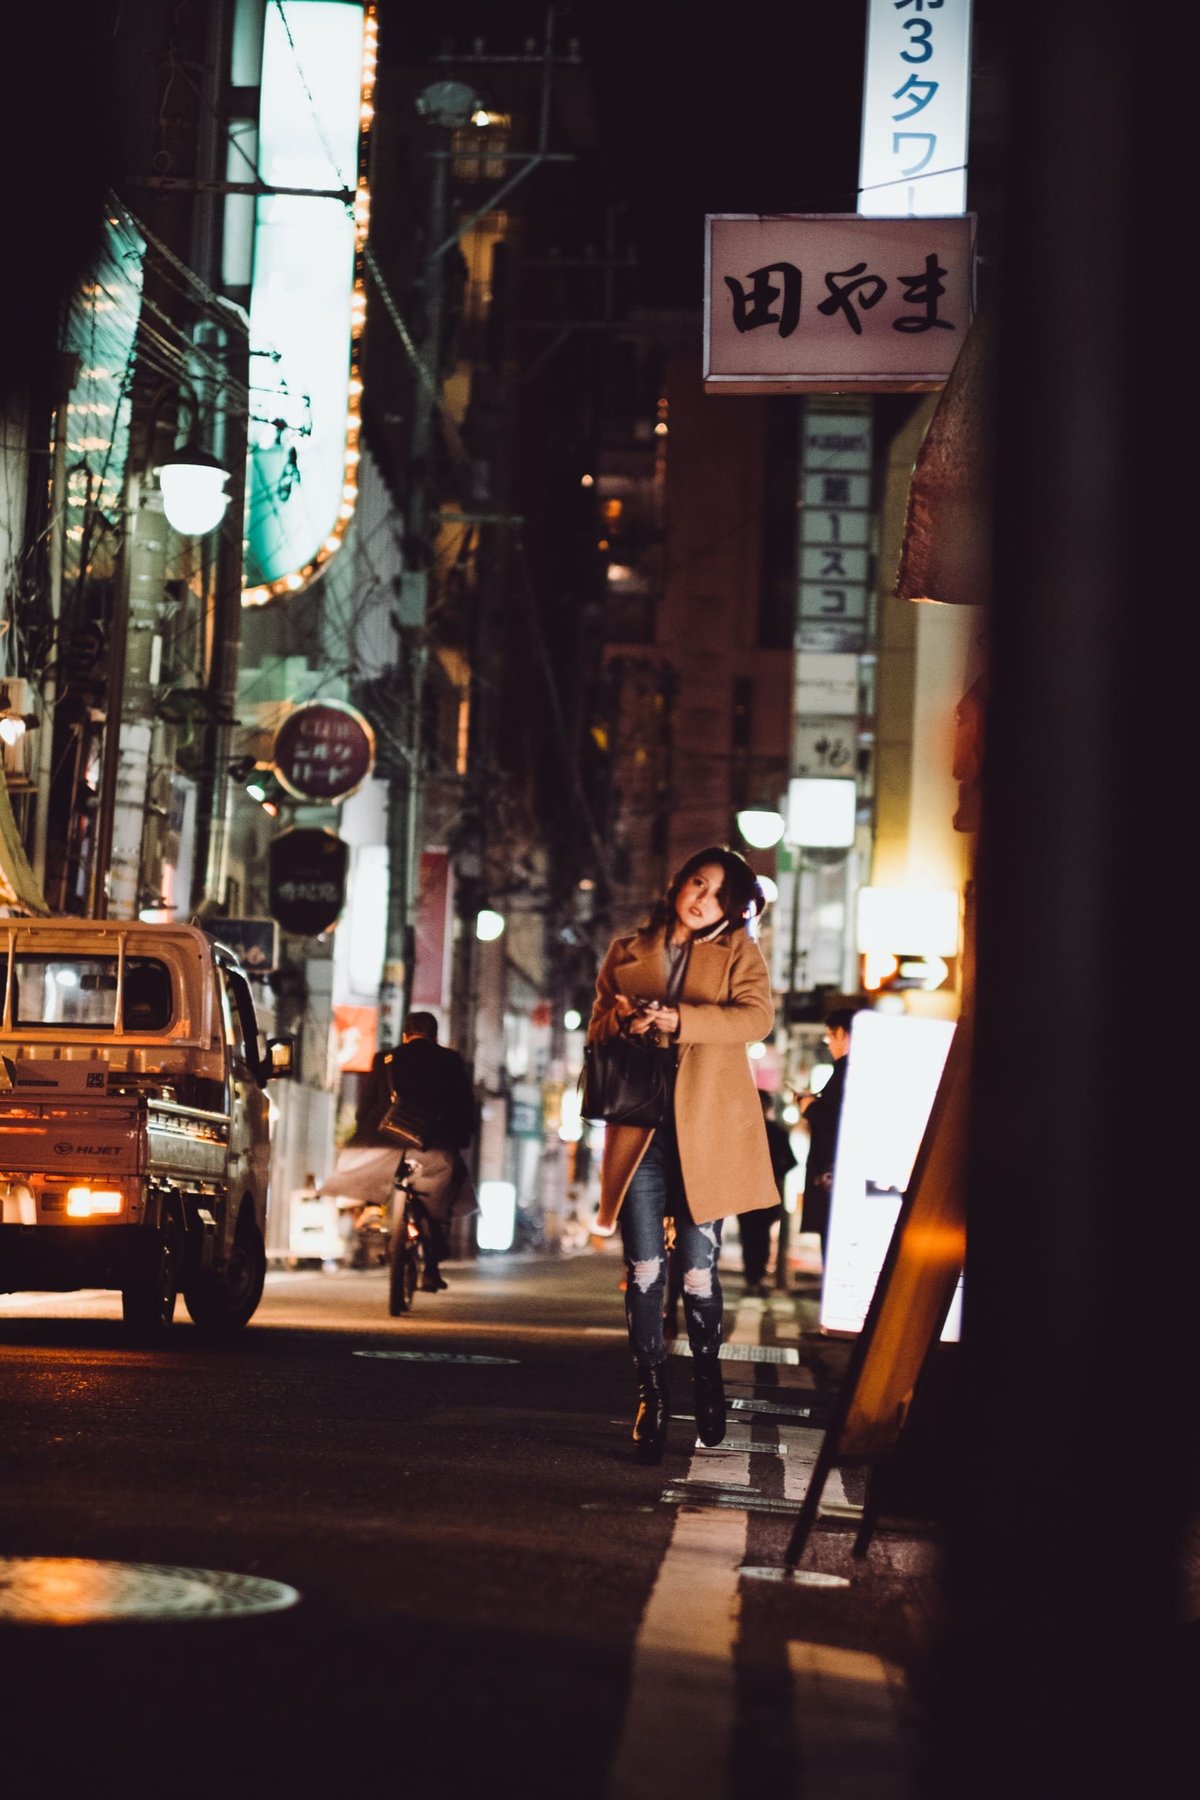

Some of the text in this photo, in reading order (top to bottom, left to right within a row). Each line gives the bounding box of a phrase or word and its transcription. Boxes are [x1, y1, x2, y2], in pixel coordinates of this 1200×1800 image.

[724, 253, 955, 339] 田やま
[76, 1145, 124, 1156] HIJET
